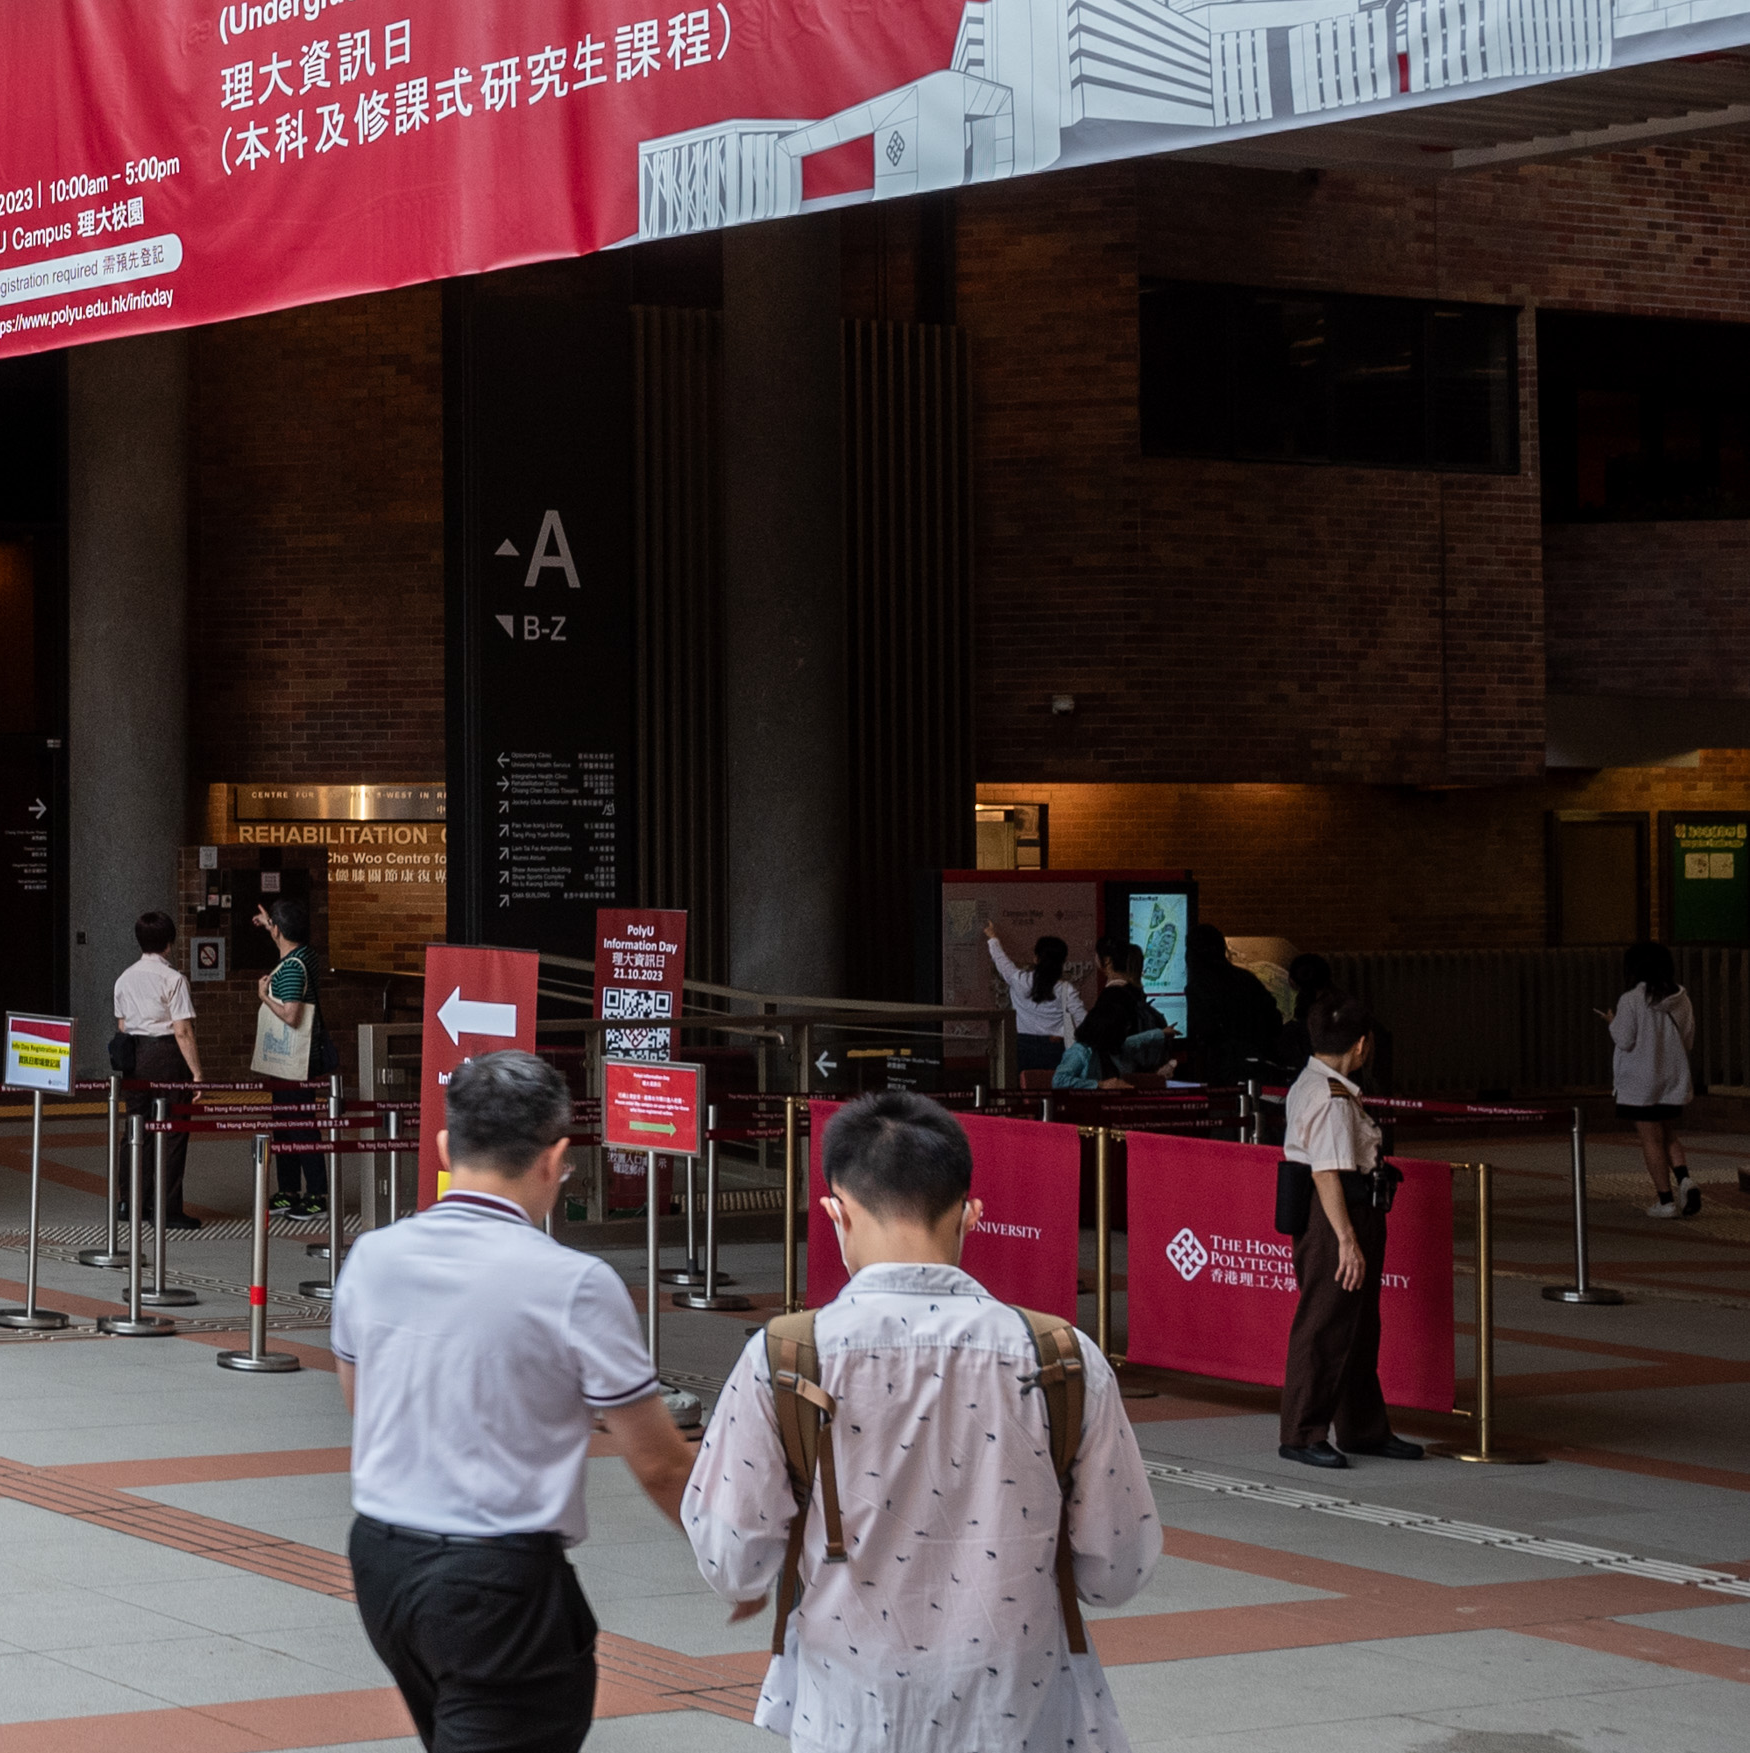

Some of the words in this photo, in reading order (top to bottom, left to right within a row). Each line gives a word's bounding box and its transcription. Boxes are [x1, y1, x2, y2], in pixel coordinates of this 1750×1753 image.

[221, 18, 413, 112] 理大資訊日
[49, 174, 109, 204] 10:00am
[125, 155, 180, 186] 5:00pm
[12, 221, 72, 256] Campus
[77, 196, 144, 238] 理大校園
[52, 258, 98, 293] required
[103, 244, 165, 276] 需預先登記
[524, 510, 581, 588] A
[523, 616, 566, 641] B-Z
[239, 826, 428, 845] REHABILITATION
[352, 852, 382, 865] Woo
[386, 852, 430, 865] Centre
[434, 852, 447, 865] fo
[627, 924, 655, 938] PolyU
[603, 938, 657, 952] Information
[658, 941, 678, 955] Day
[612, 951, 666, 969] 理大資訊日
[613, 967, 664, 982] 21.10.2023
[271, 1144, 281, 1152] ong
[1210, 1234, 1243, 1253] THE
[1245, 1238, 1292, 1259] HONG
[1210, 1251, 1295, 1275] POLYTECHN
[1210, 1268, 1297, 1293] 香港理工大學
